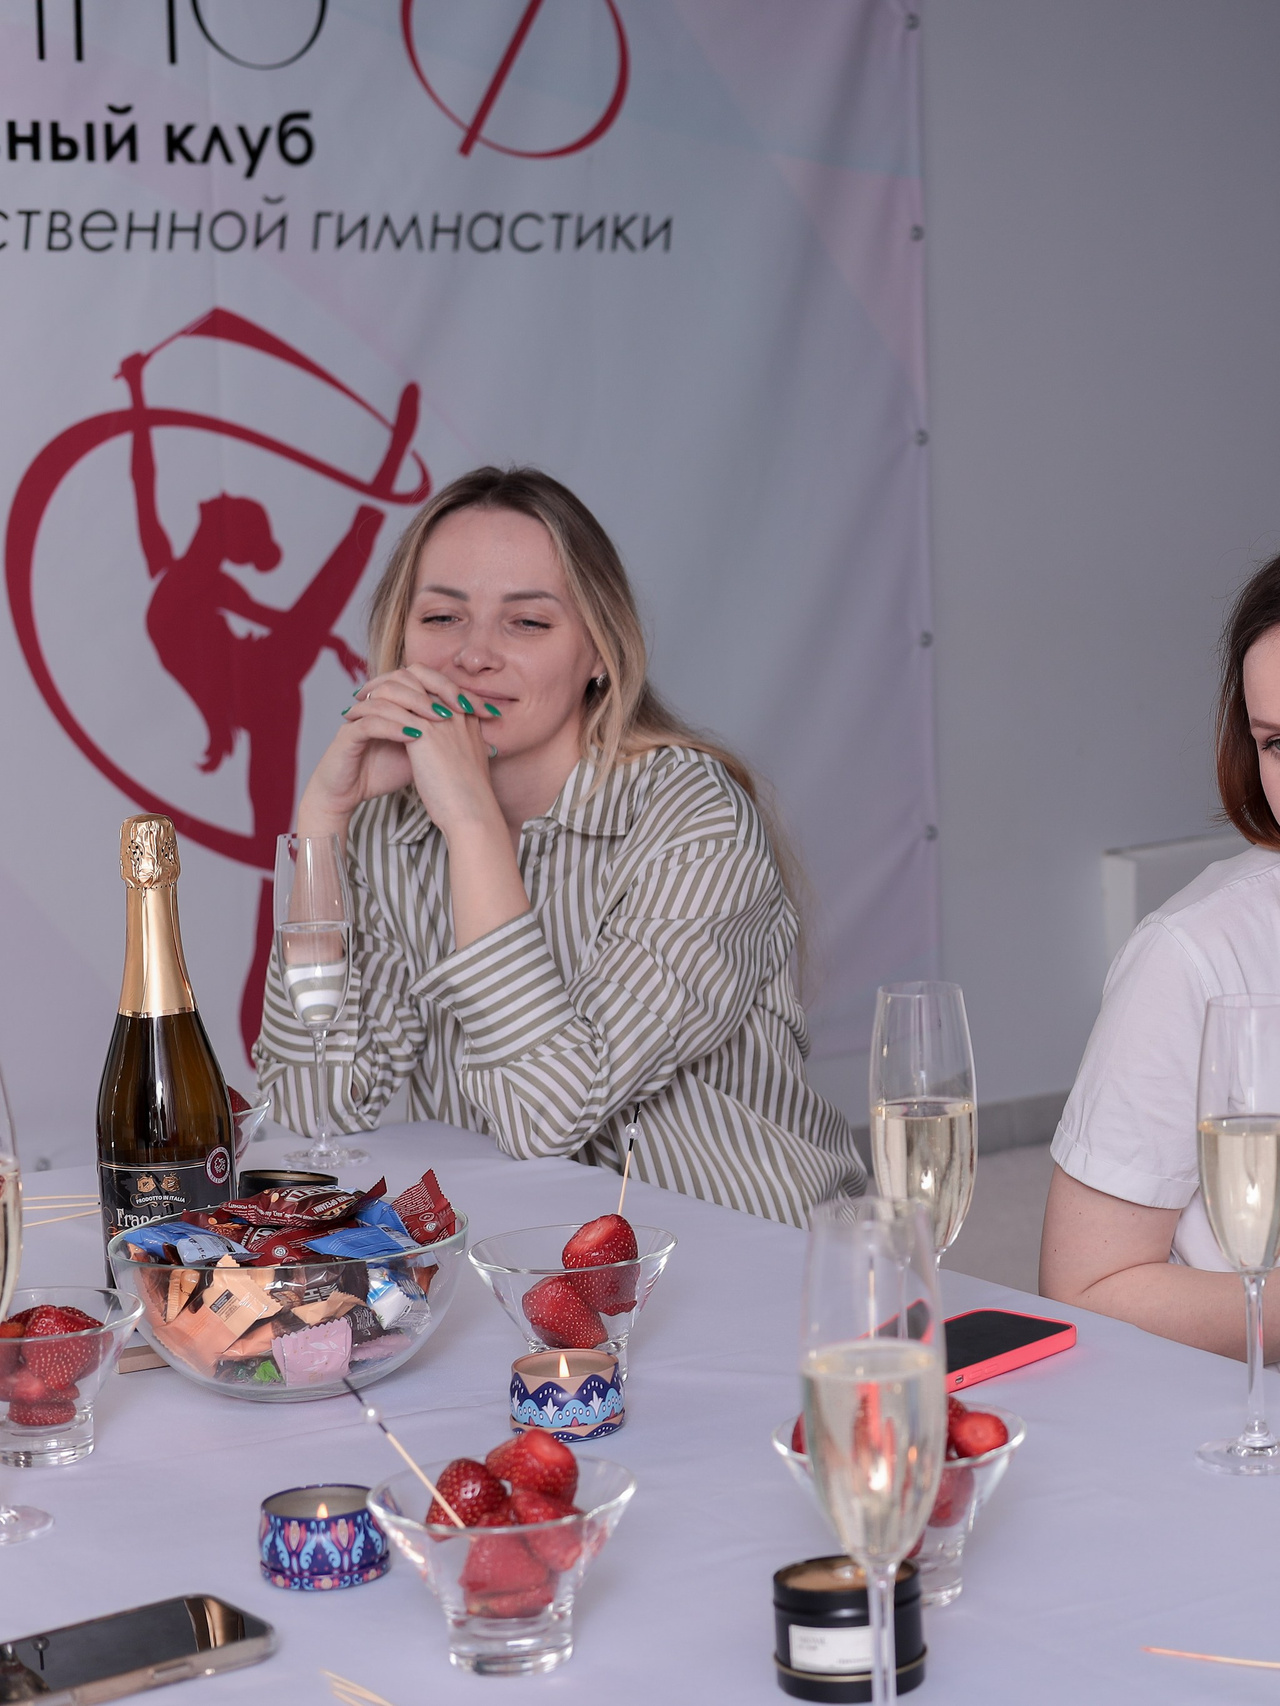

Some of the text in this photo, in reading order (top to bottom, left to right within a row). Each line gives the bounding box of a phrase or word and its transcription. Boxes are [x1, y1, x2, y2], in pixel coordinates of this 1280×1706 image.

[0, 104, 316, 179] ный клуб
[310, 211, 674, 254] гимнастики
[135, 1195, 162, 1204] PRODOTTO
[169, 1195, 186, 1203] ITALIA
